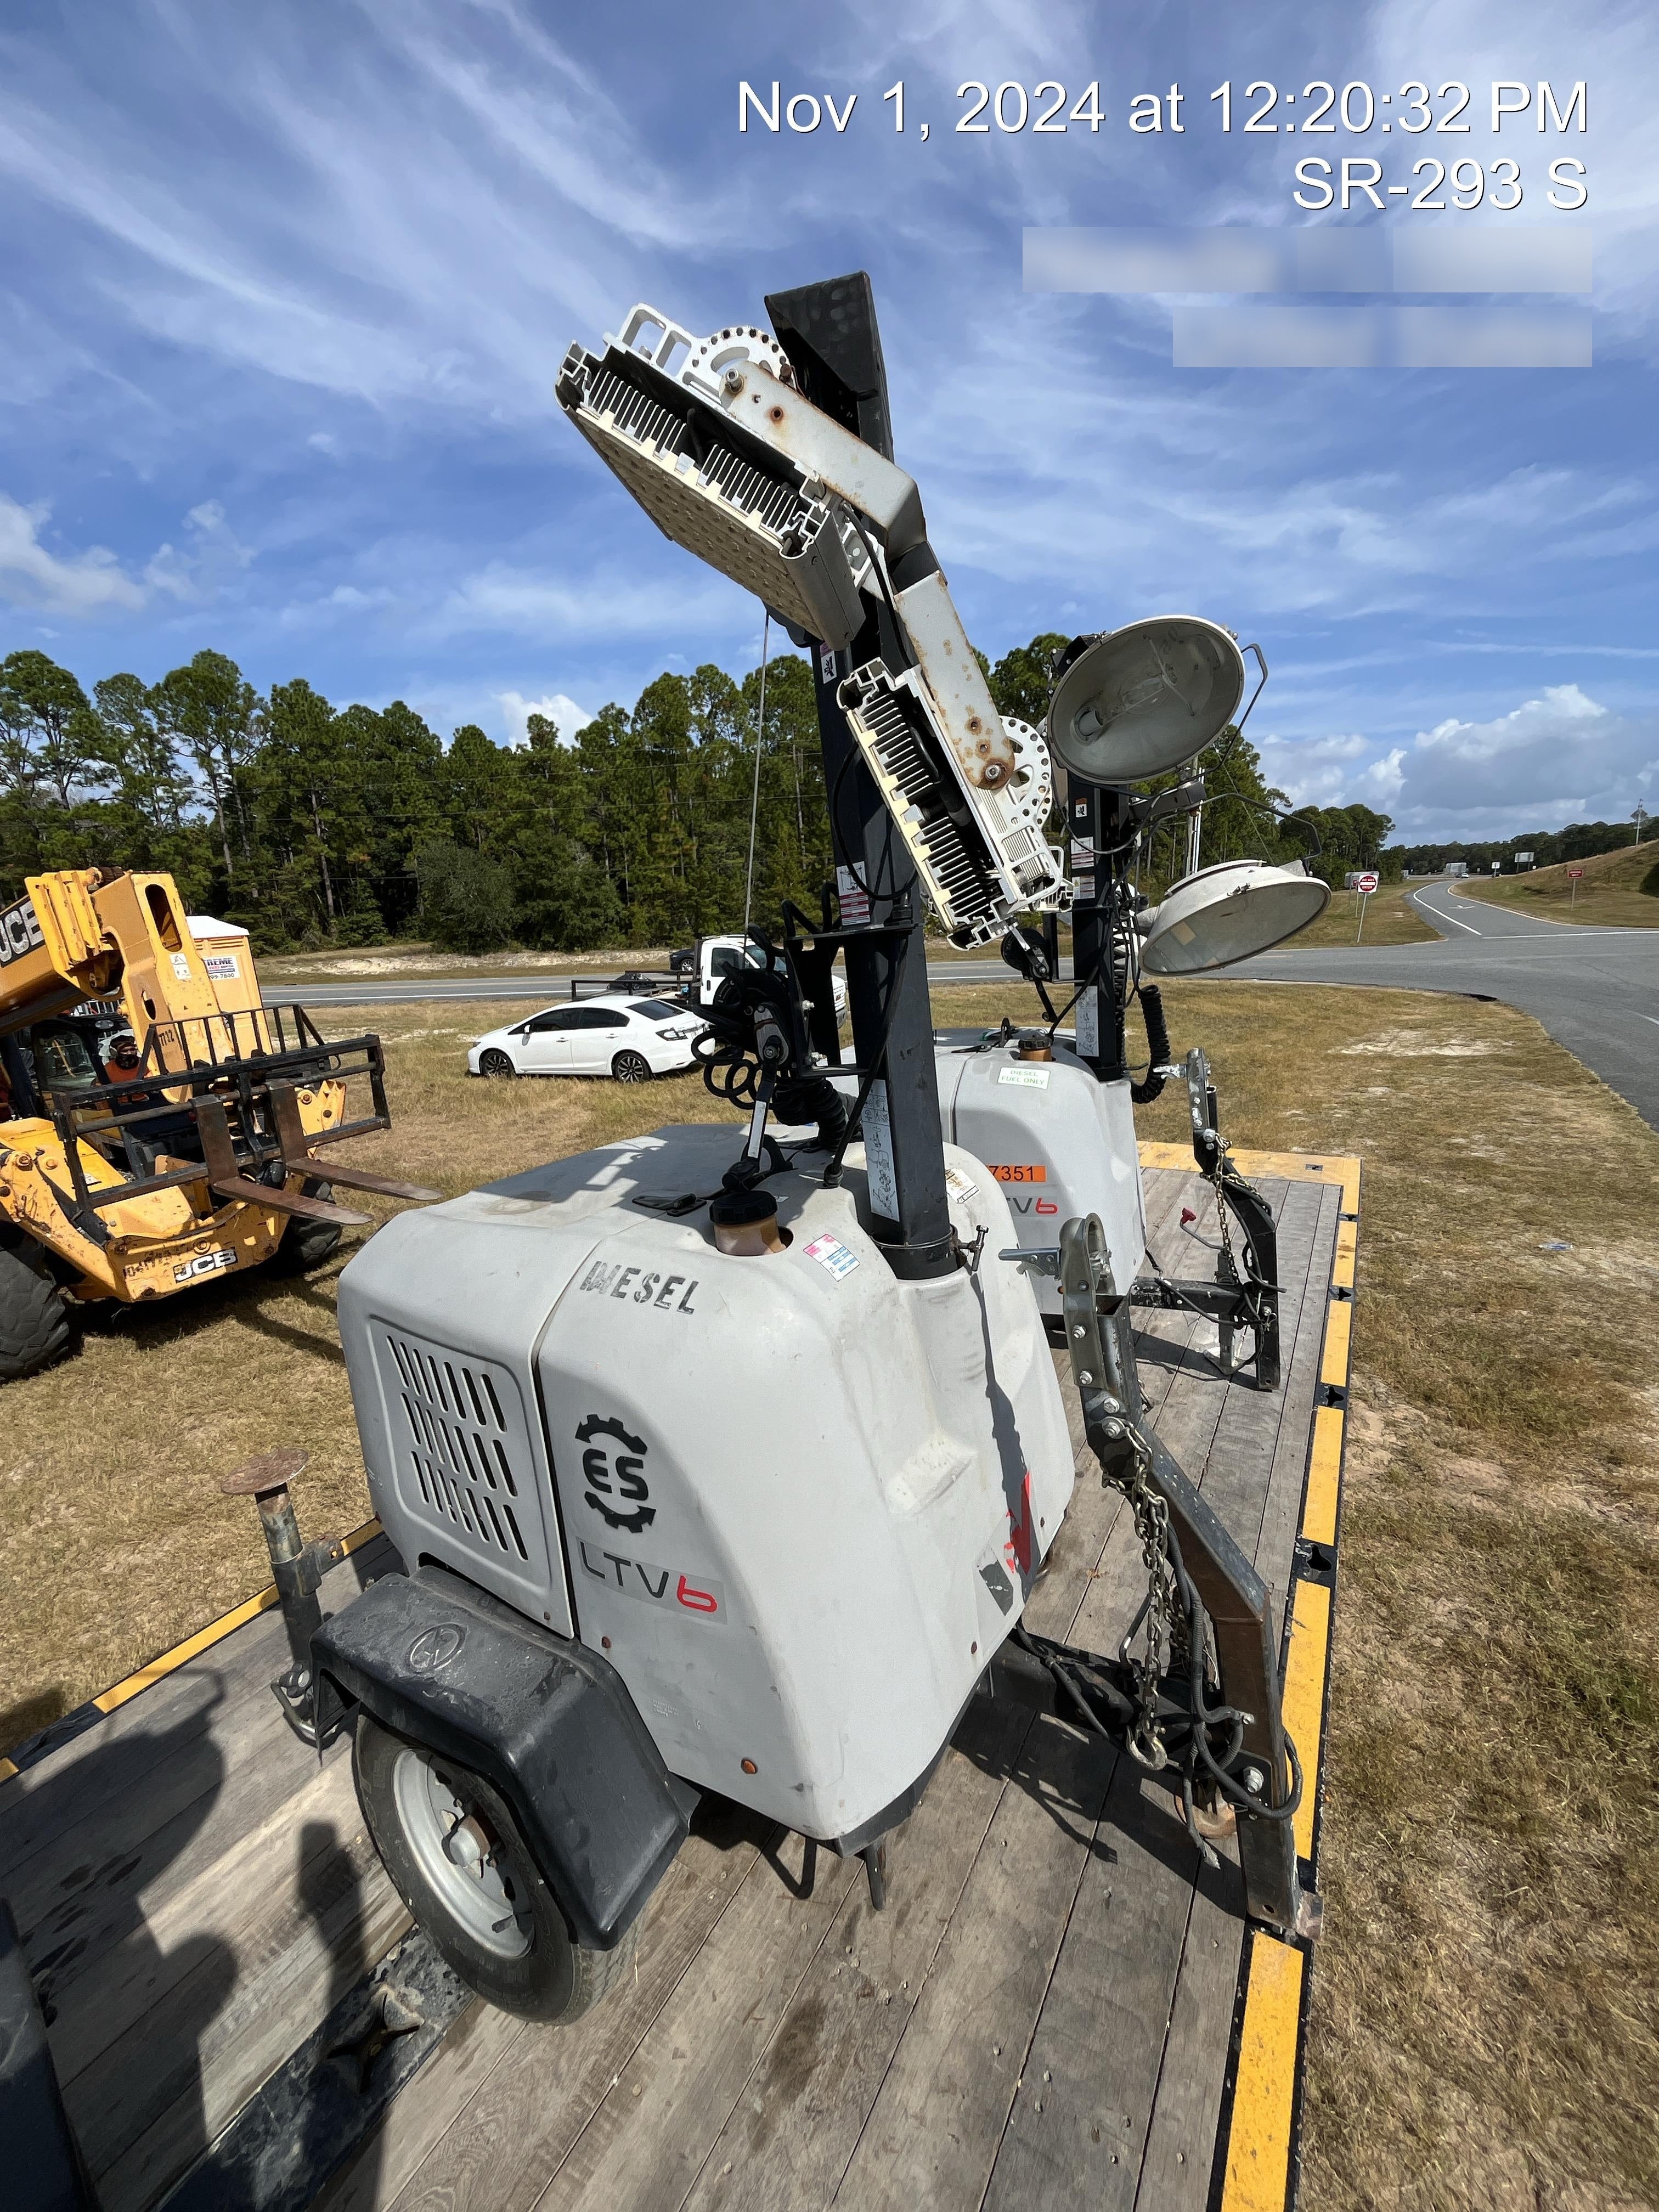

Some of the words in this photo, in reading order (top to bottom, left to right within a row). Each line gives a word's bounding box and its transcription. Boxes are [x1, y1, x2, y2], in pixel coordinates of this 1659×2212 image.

[205, 957, 234, 966] REME
[174, 1249, 237, 1282] JCB
[582, 1448, 649, 1501] ES
